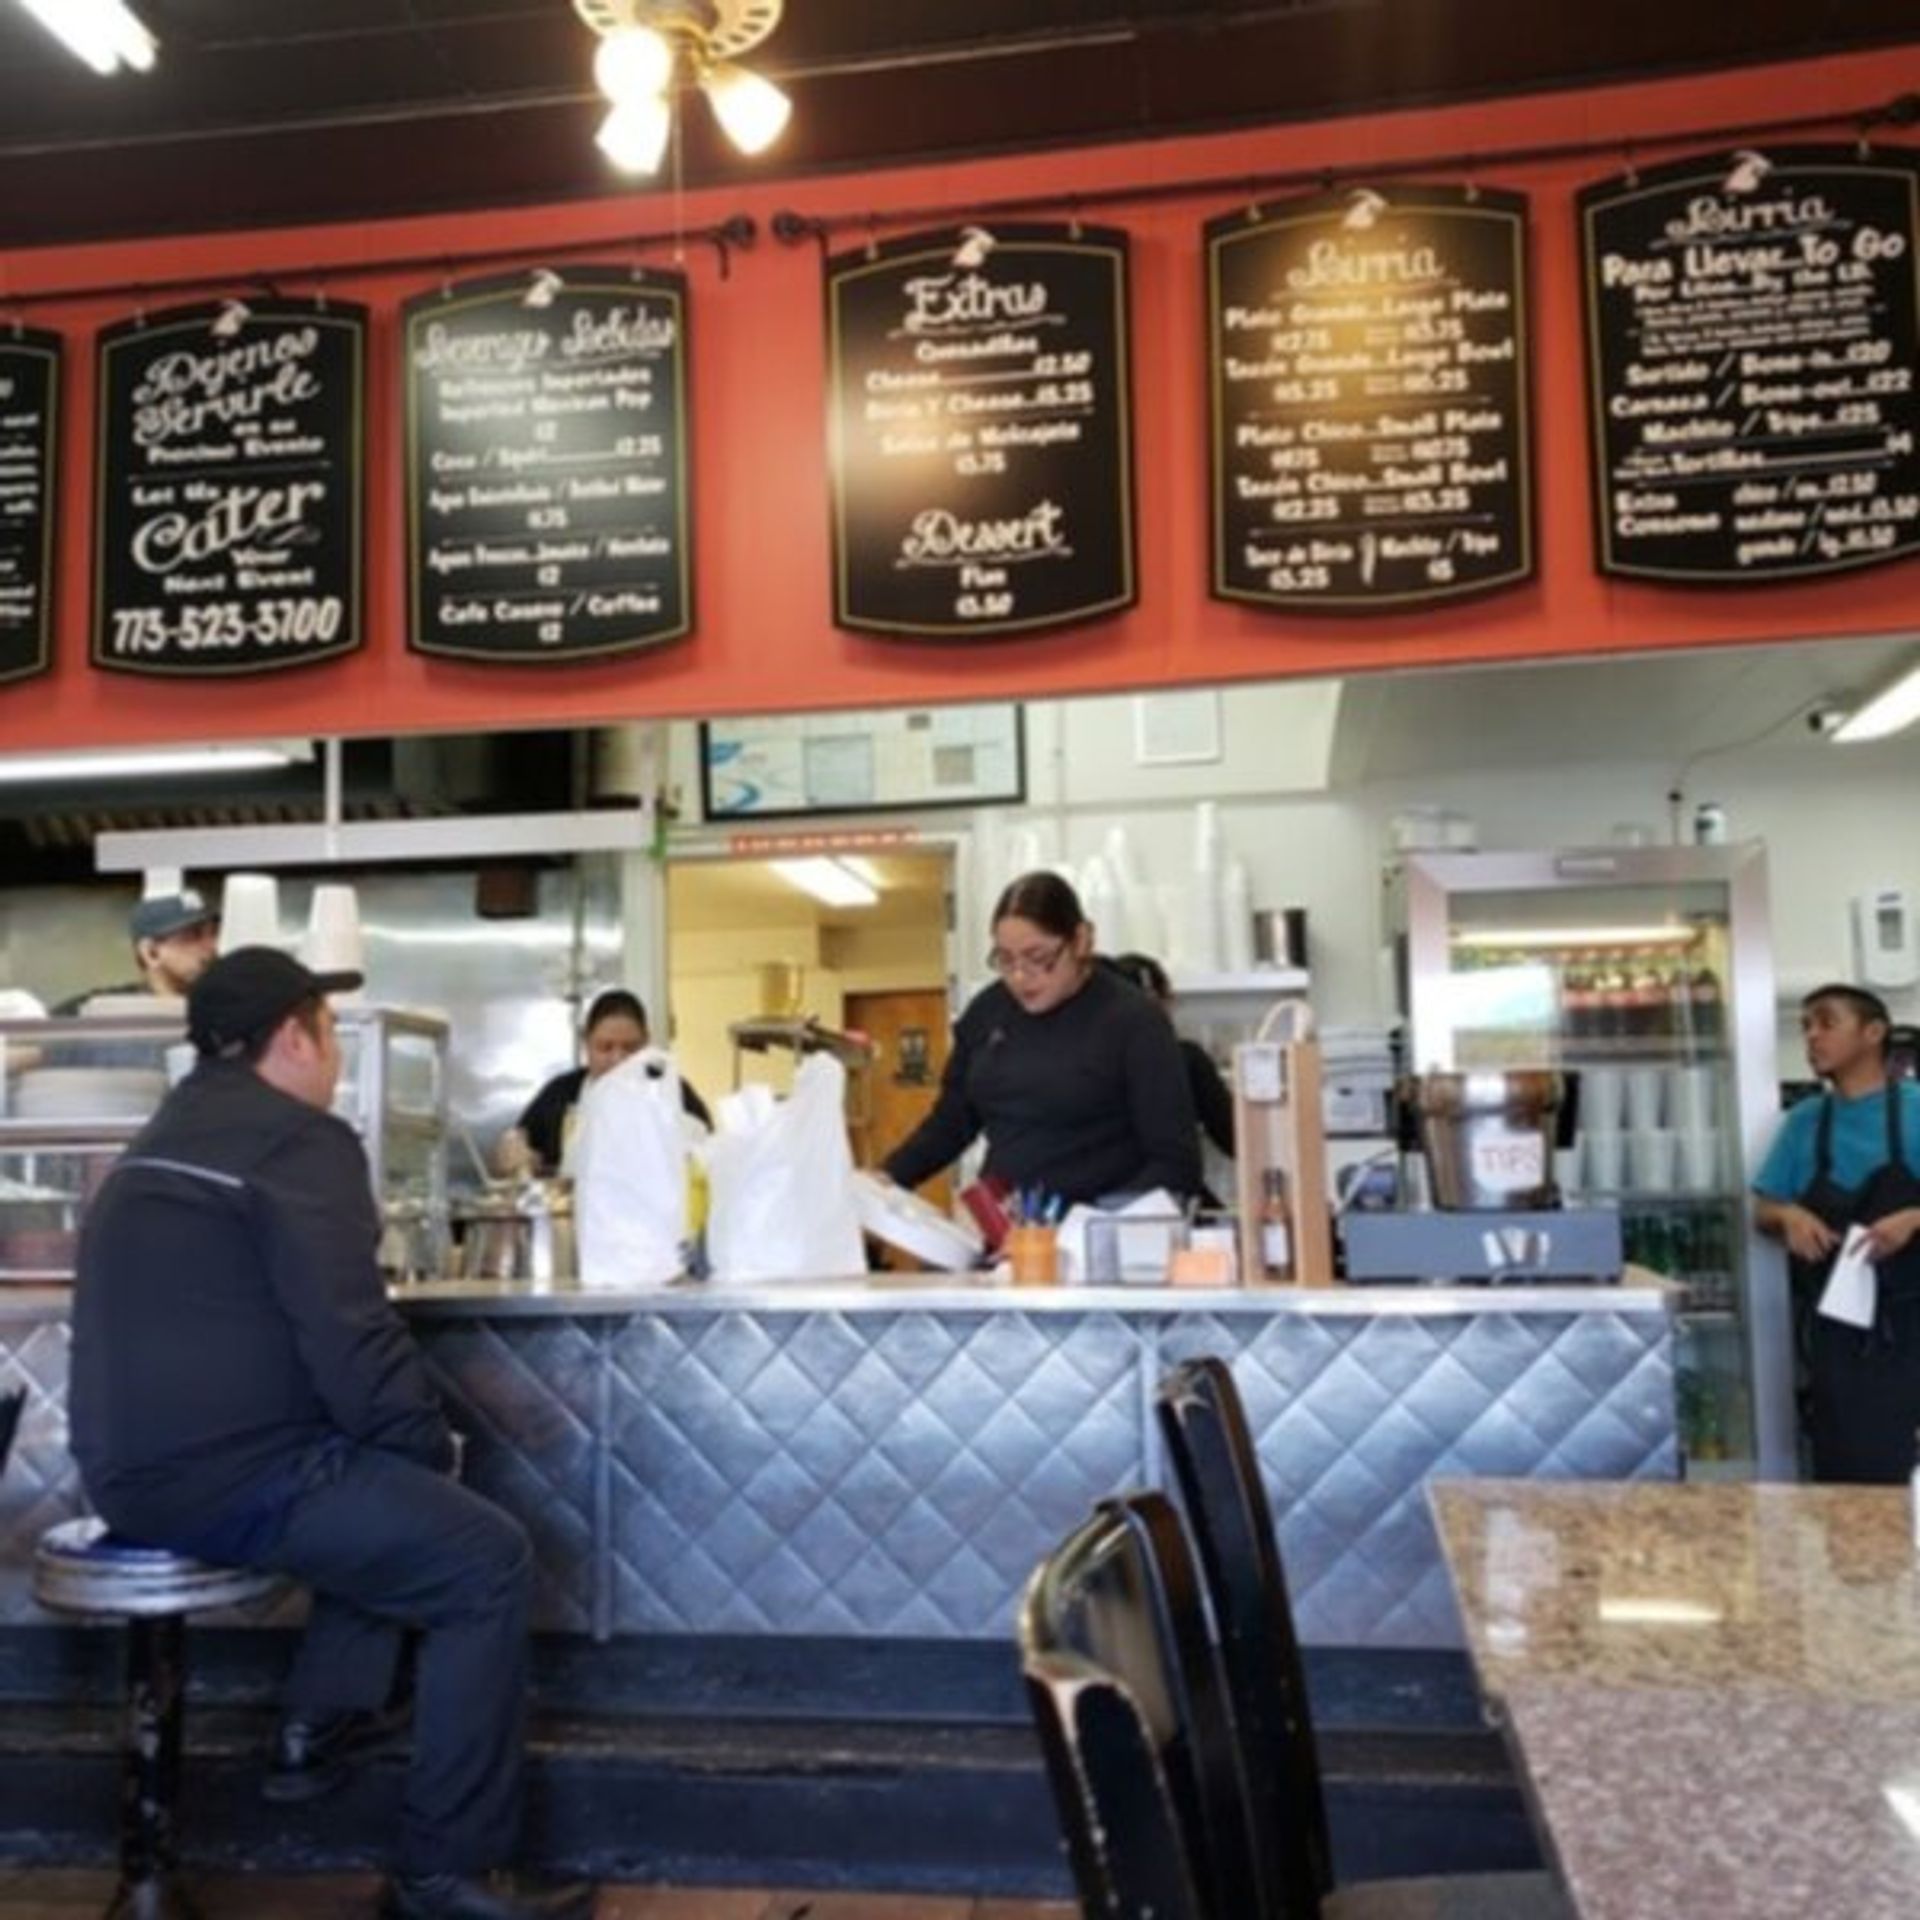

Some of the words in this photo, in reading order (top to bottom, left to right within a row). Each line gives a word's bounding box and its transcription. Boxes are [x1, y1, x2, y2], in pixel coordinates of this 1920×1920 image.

[1602, 254, 1673, 286] Para
[1685, 245, 1784, 277] Llevar
[1800, 234, 1839, 266] To
[1853, 227, 1905, 260] Go
[904, 274, 1047, 331] Extras
[132, 482, 325, 572] Cater
[901, 499, 1065, 561] Dessert
[237, 567, 315, 589] Event
[1480, 1144, 1541, 1173] TIPS
